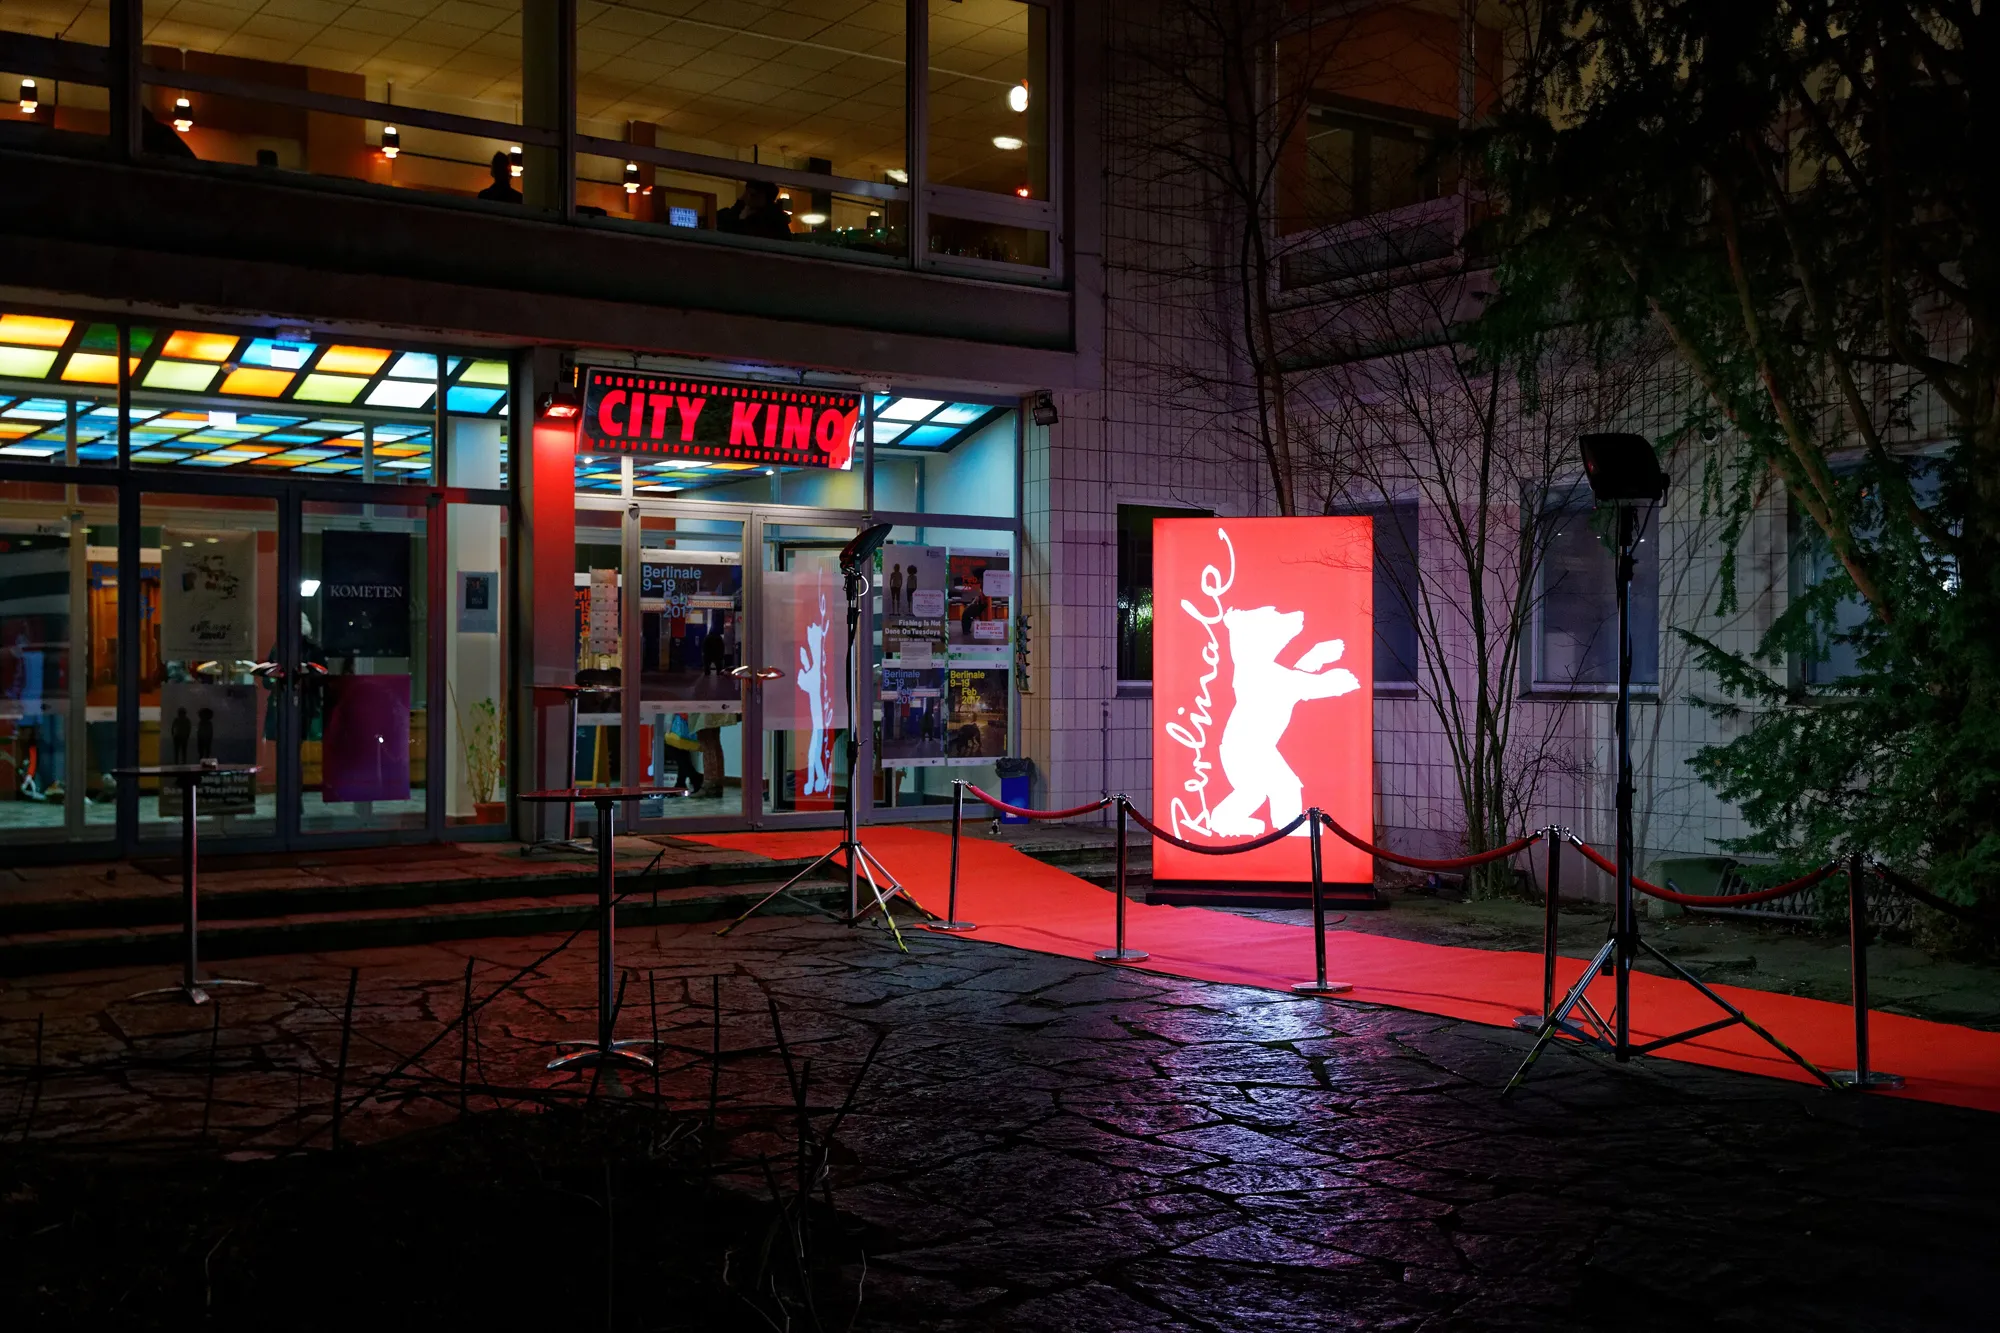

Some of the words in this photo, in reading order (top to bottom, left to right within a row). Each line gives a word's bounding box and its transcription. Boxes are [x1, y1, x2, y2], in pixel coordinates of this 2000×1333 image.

[598, 390, 707, 441] CITY
[729, 401, 846, 453] KINO
[642, 564, 702, 580] Berlinale
[329, 584, 404, 599] KOMETEN
[663, 591, 688, 605] Feb
[663, 605, 694, 619] 2017
[898, 619, 922, 628] Fishing
[884, 670, 920, 678] Berlinale
[950, 670, 985, 680] Berlinale
[1166, 528, 1236, 843] Berlinale
[896, 687, 912, 696] Feb
[961, 687, 977, 696] Feb
[896, 696, 916, 705] 2017
[961, 696, 981, 705] 2017
